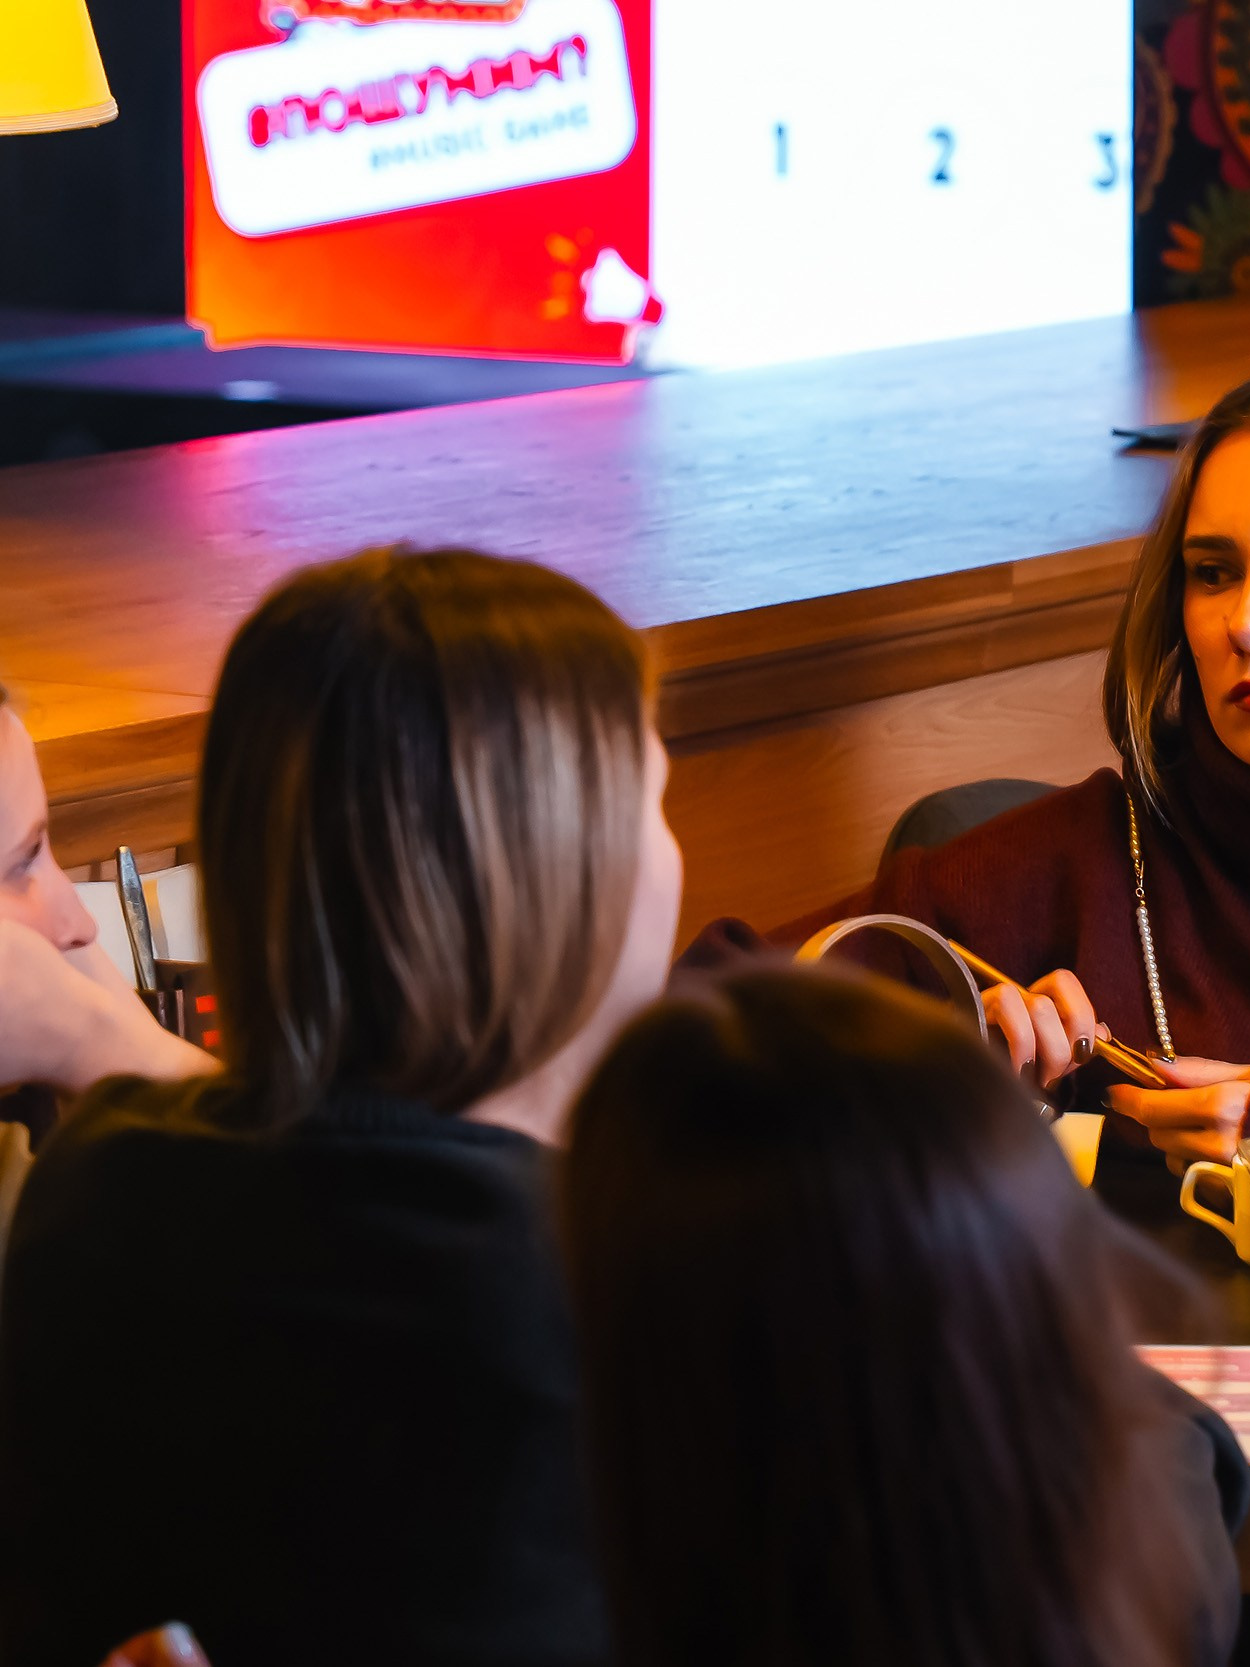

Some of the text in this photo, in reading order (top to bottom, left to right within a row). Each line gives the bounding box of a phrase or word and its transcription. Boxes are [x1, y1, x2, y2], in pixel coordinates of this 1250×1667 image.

[773, 121, 1119, 193] 1 2 3
